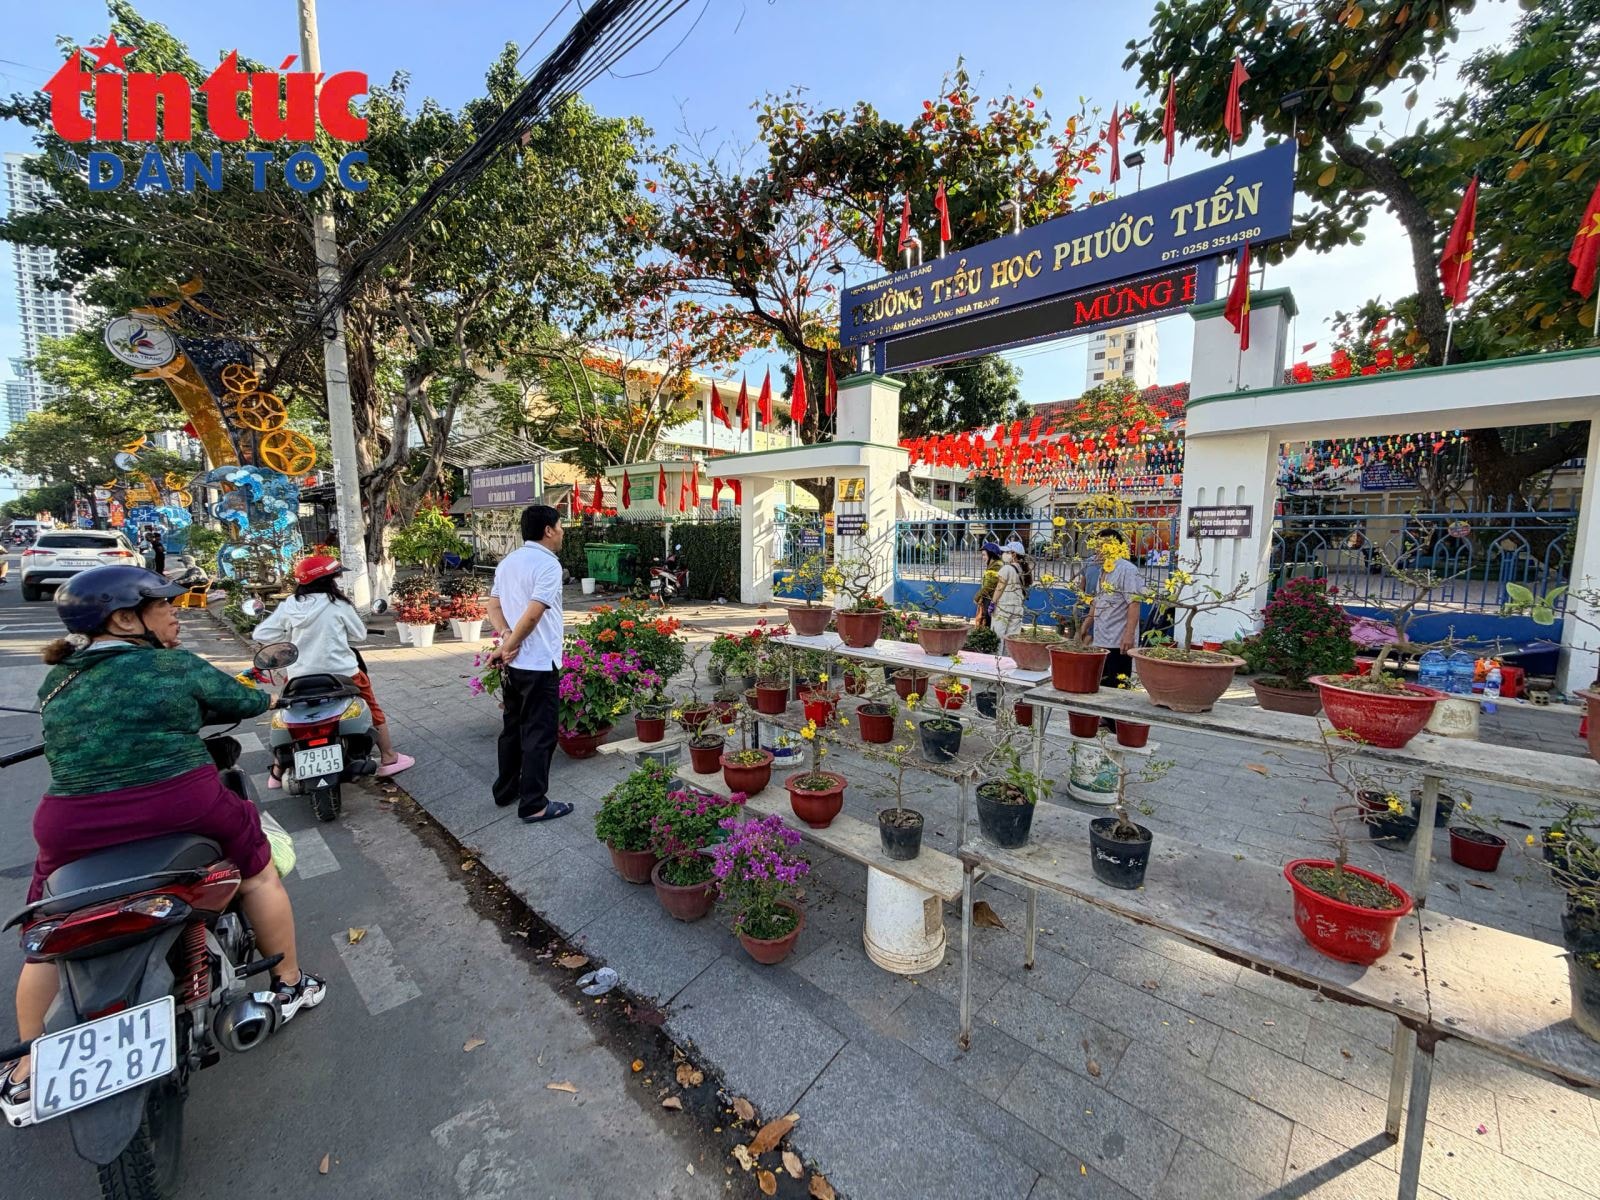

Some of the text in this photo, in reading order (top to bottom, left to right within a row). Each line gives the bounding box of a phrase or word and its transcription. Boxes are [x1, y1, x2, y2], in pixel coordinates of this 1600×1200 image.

[852, 175, 1263, 327] TRƯỜNG TIỂU HỌC PHƯỚC TIẾN
[1161, 227, 1262, 261] ĐT: 0258 3514380
[894, 272, 909, 284] NHA
[910, 264, 933, 279] TRANG
[955, 303, 972, 315] NHA
[973, 296, 1000, 311] TRANG
[300, 758, 339, 777] 014.35
[58, 1009, 151, 1071] 79-N1
[43, 1038, 166, 1110] 462.87
